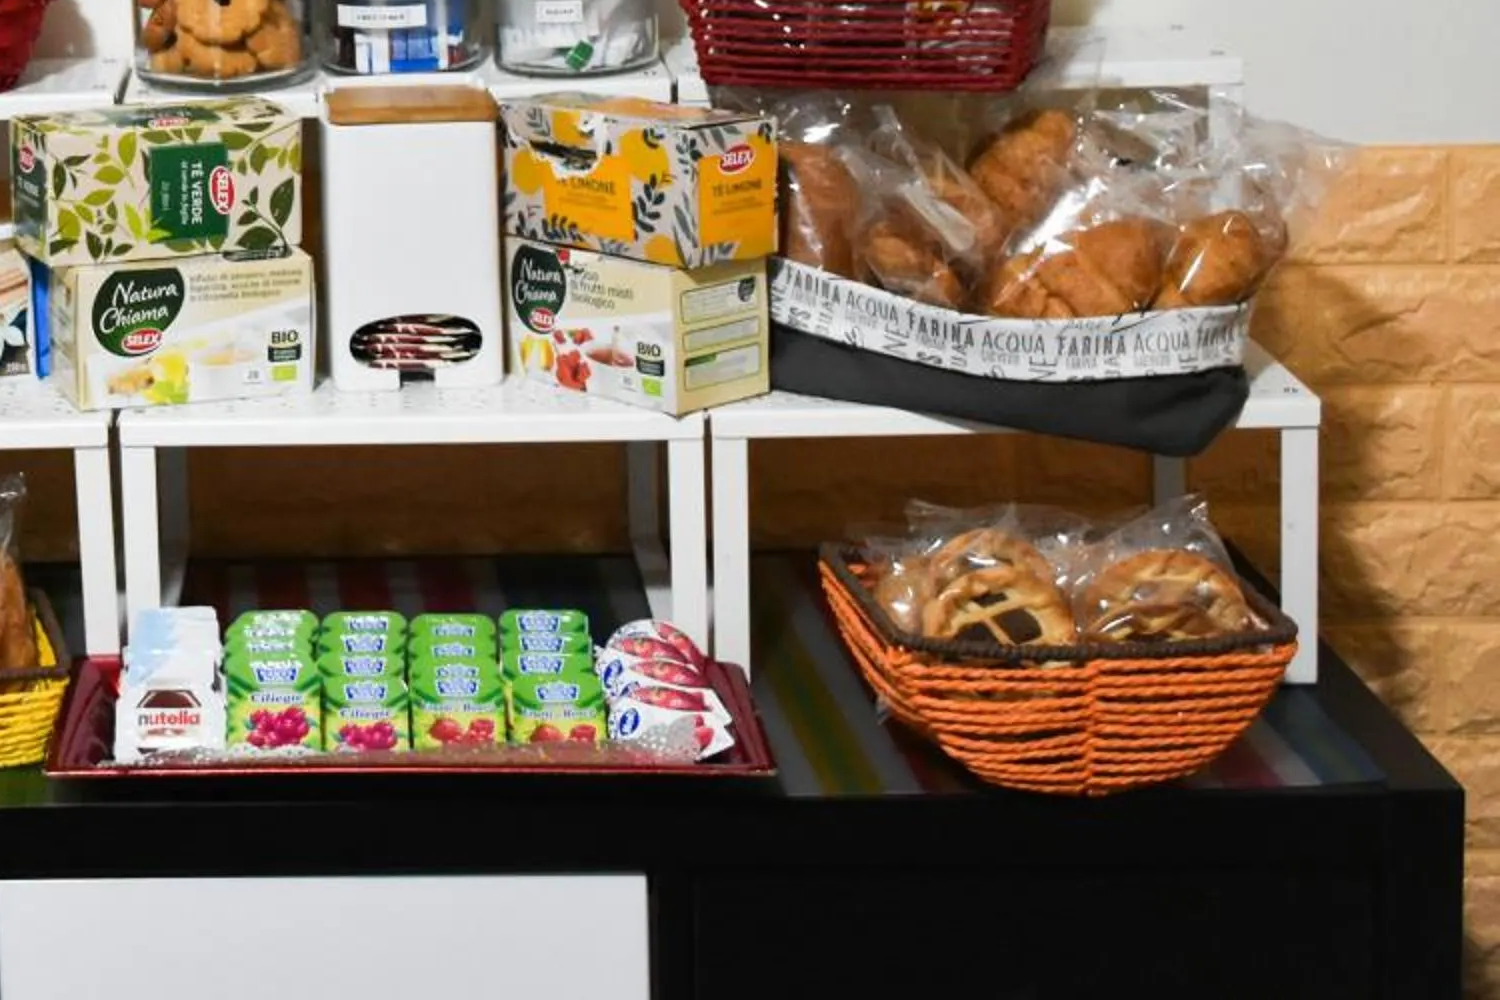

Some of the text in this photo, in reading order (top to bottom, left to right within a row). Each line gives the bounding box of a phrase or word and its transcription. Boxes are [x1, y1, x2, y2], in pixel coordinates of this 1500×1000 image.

[723, 150, 752, 167] SELEX
[191, 181, 203, 225] VERDE
[217, 172, 229, 209] SELEX
[520, 258, 562, 285] Natura
[111, 280, 179, 307] Natura
[515, 280, 557, 305] Chiama
[100, 305, 169, 334] Chiama
[845, 289, 899, 325] ACQUA
[907, 311, 975, 348] FARINA
[982, 329, 1046, 354] ACQUA
[1056, 333, 1126, 357] FARINA
[1133, 331, 1191, 353] ACQUA
[125, 333, 160, 347] SELEX
[271, 329, 299, 345] BIO
[636, 341, 661, 357] BIO
[138, 709, 201, 726] nutella
